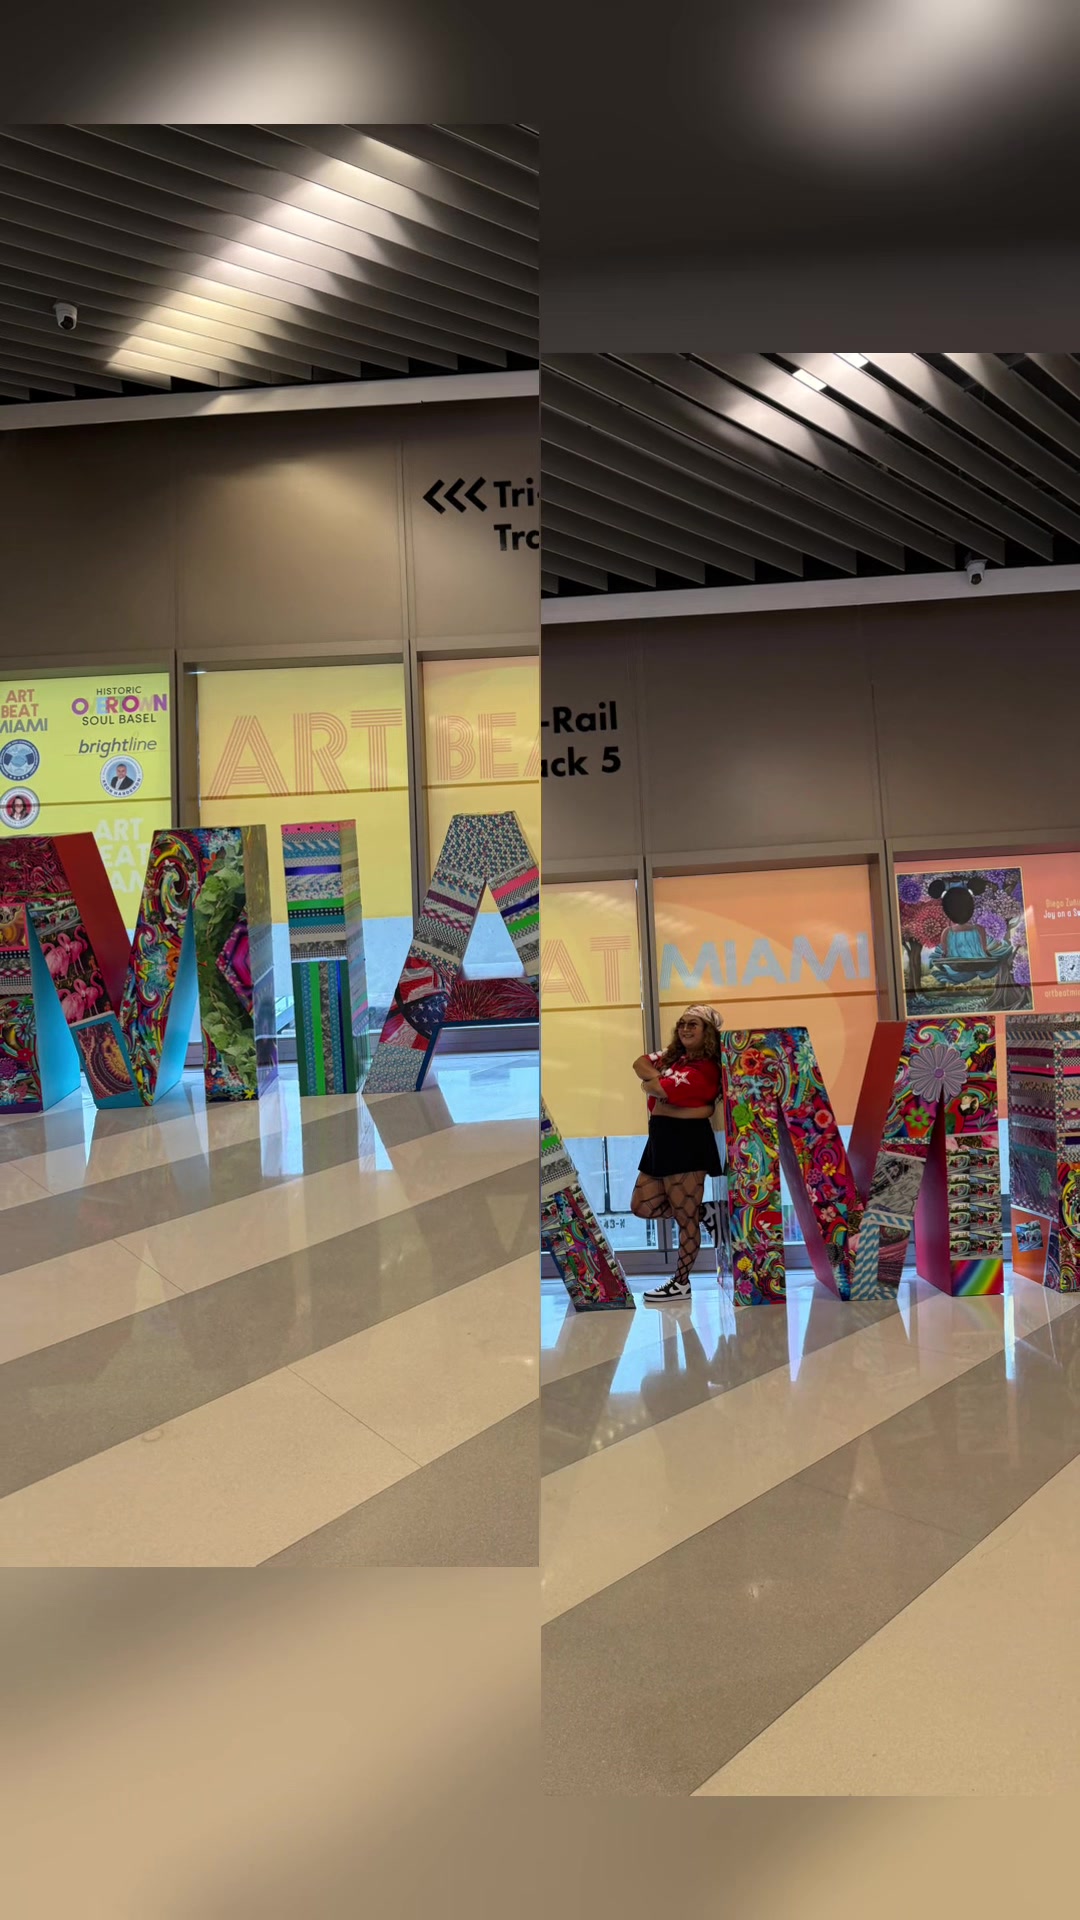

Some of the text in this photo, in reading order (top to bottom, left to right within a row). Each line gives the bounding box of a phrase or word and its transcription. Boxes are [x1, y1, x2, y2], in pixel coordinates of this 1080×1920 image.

[493, 477, 539, 508] Tri
[5, 688, 35, 703] ART
[96, 686, 142, 696] HISTORIC
[1, 703, 39, 718] BEAT
[72, 693, 168, 715] OVERTOWN
[82, 713, 157, 726] SOUL BASEL
[78, 736, 158, 758] brightline
[206, 708, 402, 800] ART
[601, 746, 621, 773] 5
[95, 817, 144, 841] ART
[100, 843, 150, 868] EAT
[659, 932, 871, 991] MIAMI
